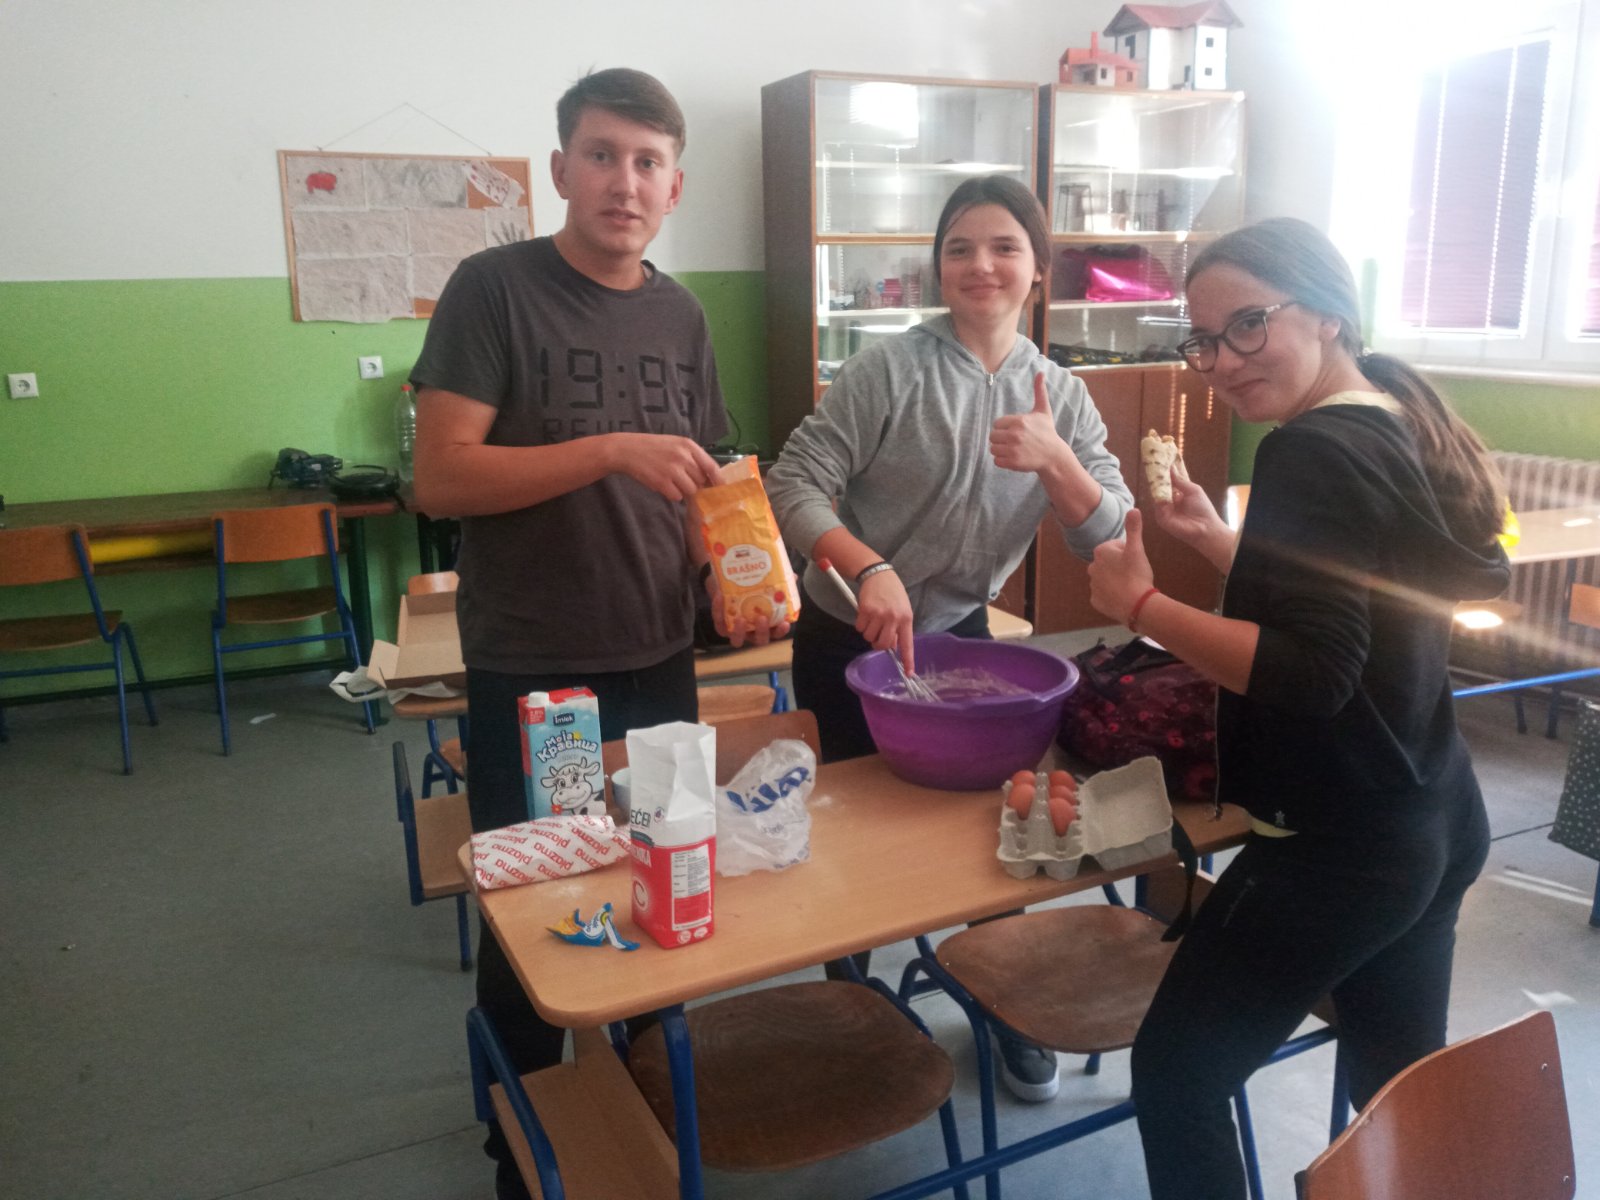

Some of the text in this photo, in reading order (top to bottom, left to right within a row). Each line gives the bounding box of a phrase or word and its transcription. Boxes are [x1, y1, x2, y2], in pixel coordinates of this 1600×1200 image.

[529, 828, 571, 849] plazma
[571, 827, 611, 856] plazma
[491, 843, 533, 866] plazma
[533, 842, 574, 872] plazma
